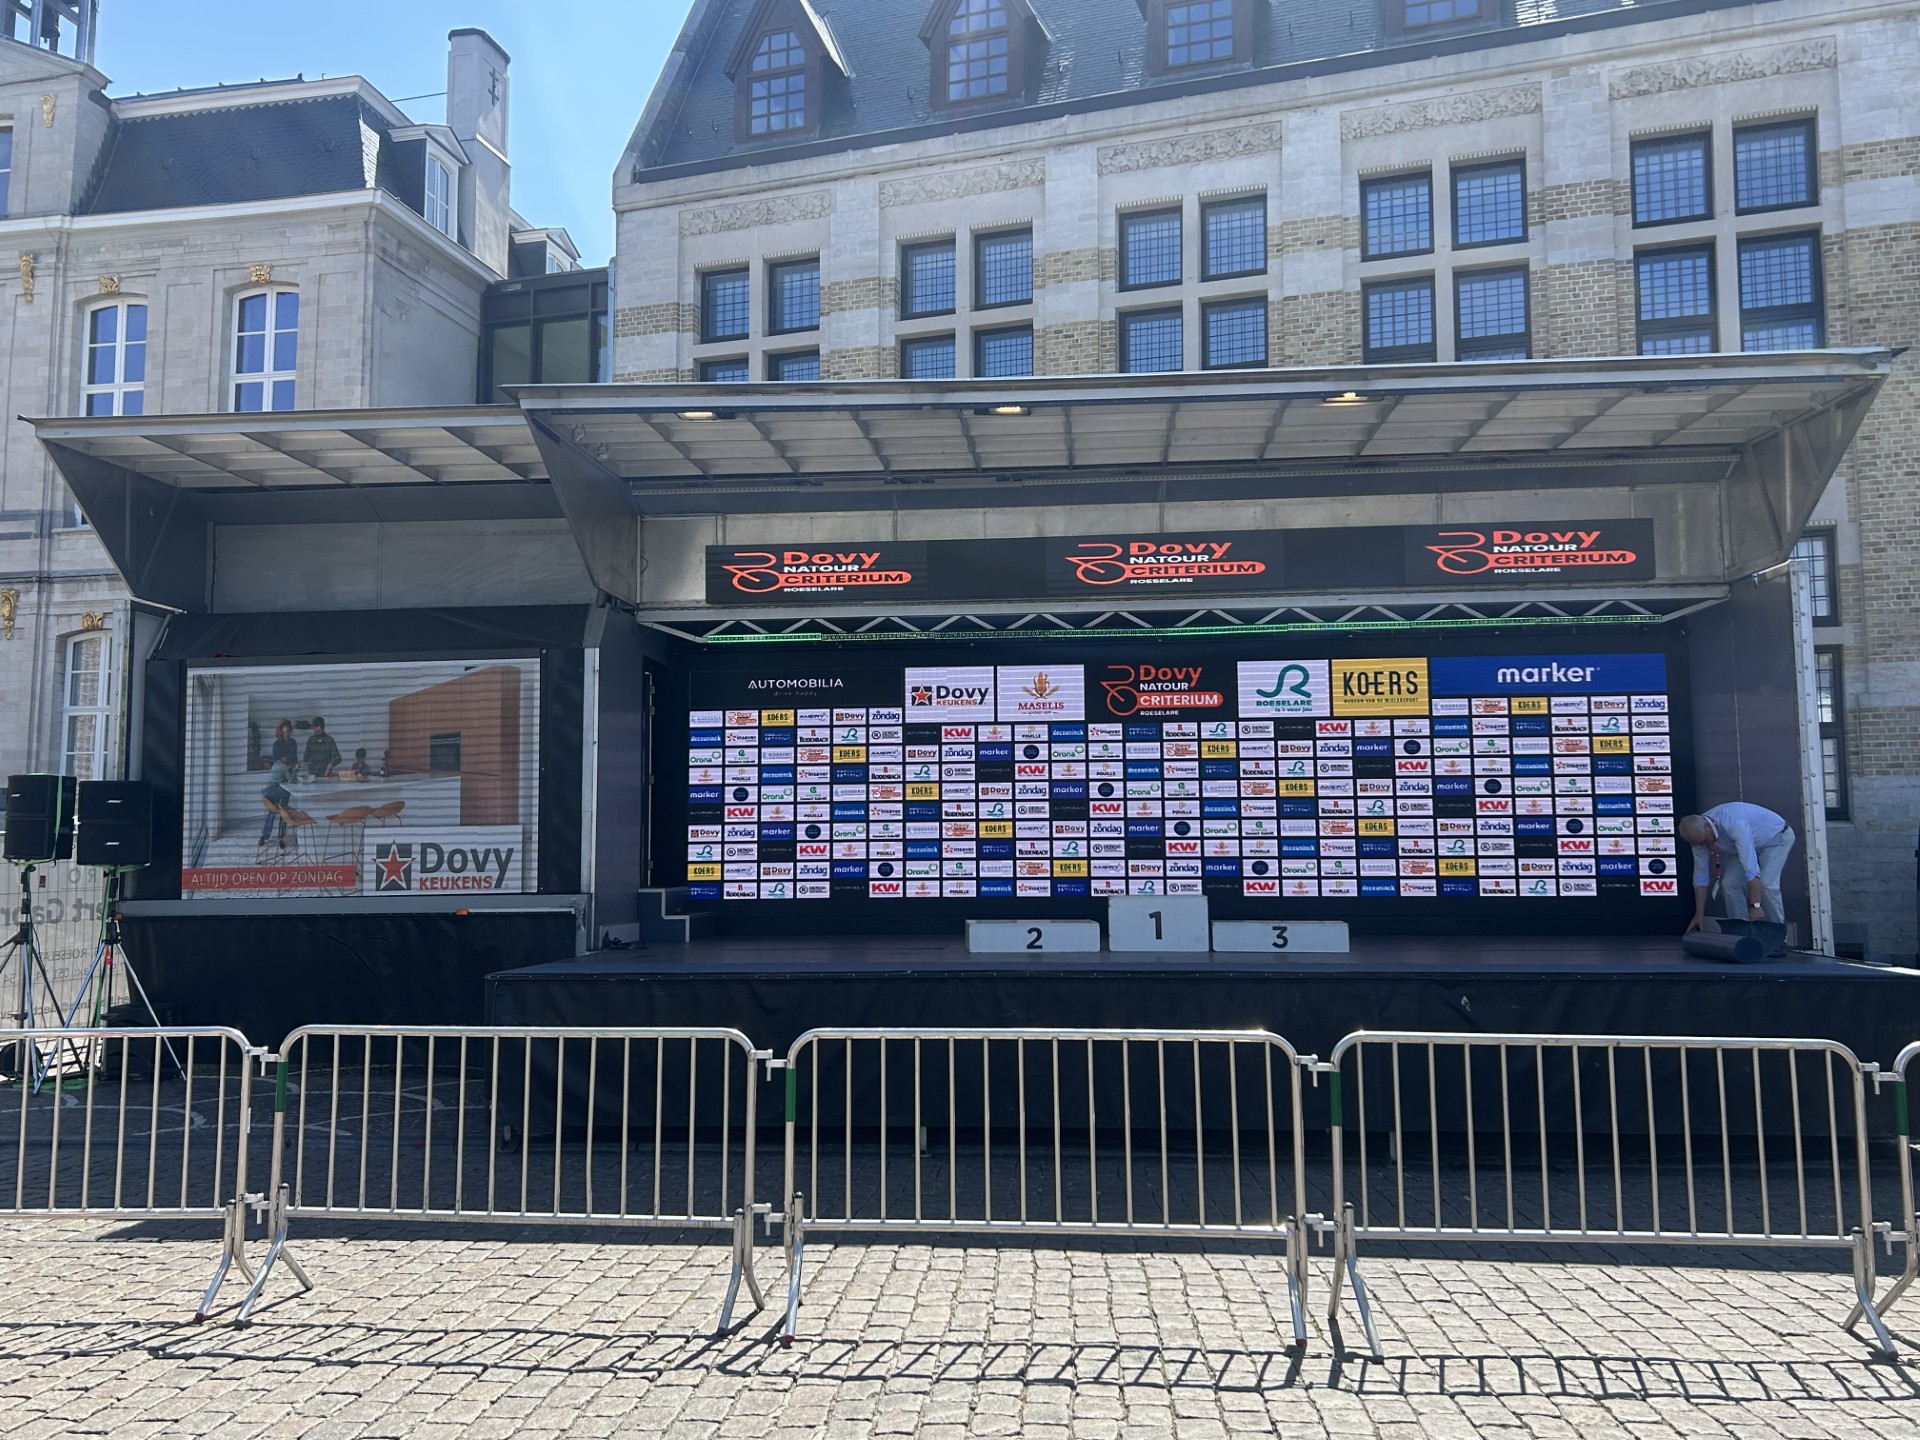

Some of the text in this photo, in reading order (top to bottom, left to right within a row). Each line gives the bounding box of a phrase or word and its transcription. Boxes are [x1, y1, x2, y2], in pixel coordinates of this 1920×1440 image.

[1493, 530, 1601, 548] Dovy
[1130, 542, 1232, 559] Dovy
[1493, 544, 1577, 552] NATOUR
[784, 551, 880, 568] Dovy
[1130, 555, 1209, 564] NATOUR
[1494, 554, 1627, 564] CRITERIUM
[1130, 564, 1256, 575] CRITERIUM
[784, 574, 904, 584] CRITERIUM
[1140, 664, 1202, 687] Dovy
[1497, 662, 1594, 683] marker
[748, 678, 843, 689] AUTOMOBILIA
[1140, 682, 1188, 690] NATOUR
[1343, 671, 1418, 696] KOERS
[936, 686, 989, 705] Dovy
[1140, 694, 1218, 706] CRITERIUM
[1018, 702, 1064, 710] MASELIS
[944, 728, 972, 736] KW
[1319, 723, 1348, 731] KW
[1018, 765, 1046, 774] KW
[1398, 761, 1428, 770] KW
[1092, 804, 1121, 812] KW
[1479, 800, 1509, 809] KW
[728, 808, 755, 816] KW
[800, 845, 827, 854] KW
[1169, 842, 1198, 851] KW
[1561, 840, 1592, 849] KW
[420, 843, 514, 888] Dovy
[191, 871, 343, 887] ALTIJD OPEN OP ZONDAG
[420, 876, 492, 890] KEUKENS
[872, 883, 900, 892] KW
[1246, 882, 1276, 890] KW
[1643, 881, 1674, 890] KW
[1149, 911, 1162, 940] 1
[1026, 927, 1043, 949] 2
[1271, 926, 1288, 948] 3
